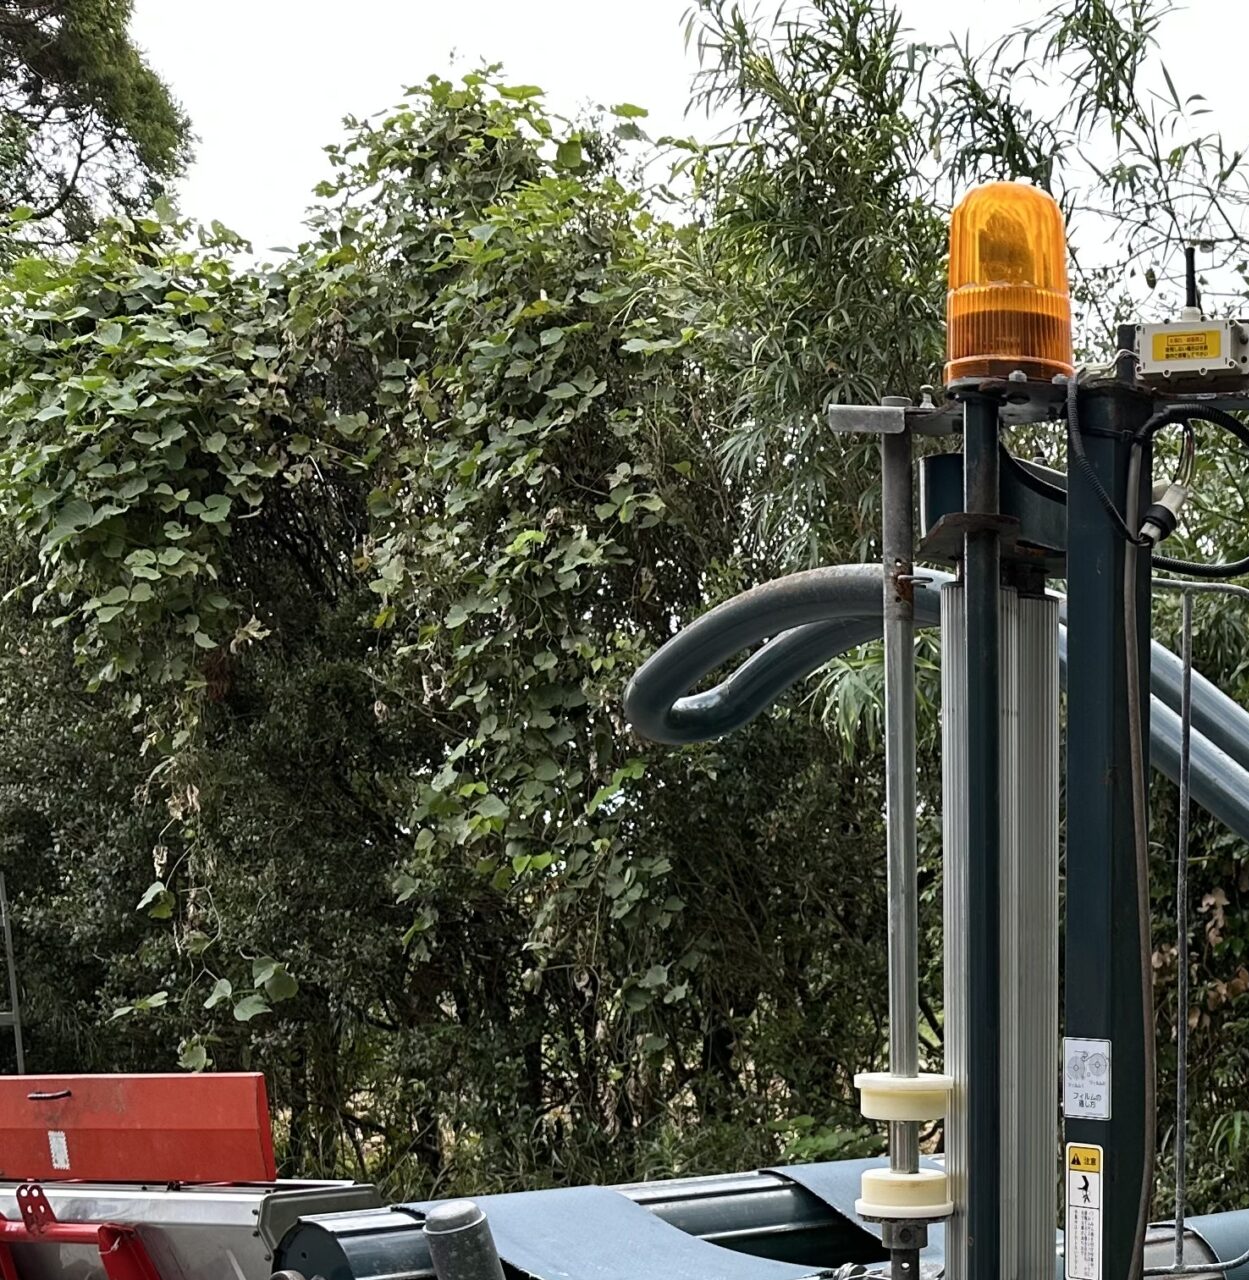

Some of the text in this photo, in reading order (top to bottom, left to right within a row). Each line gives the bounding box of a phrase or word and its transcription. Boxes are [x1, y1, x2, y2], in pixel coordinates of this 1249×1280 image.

[1073, 1092, 1101, 1101] フィルムの
[1084, 1156, 1096, 1165] 注意
